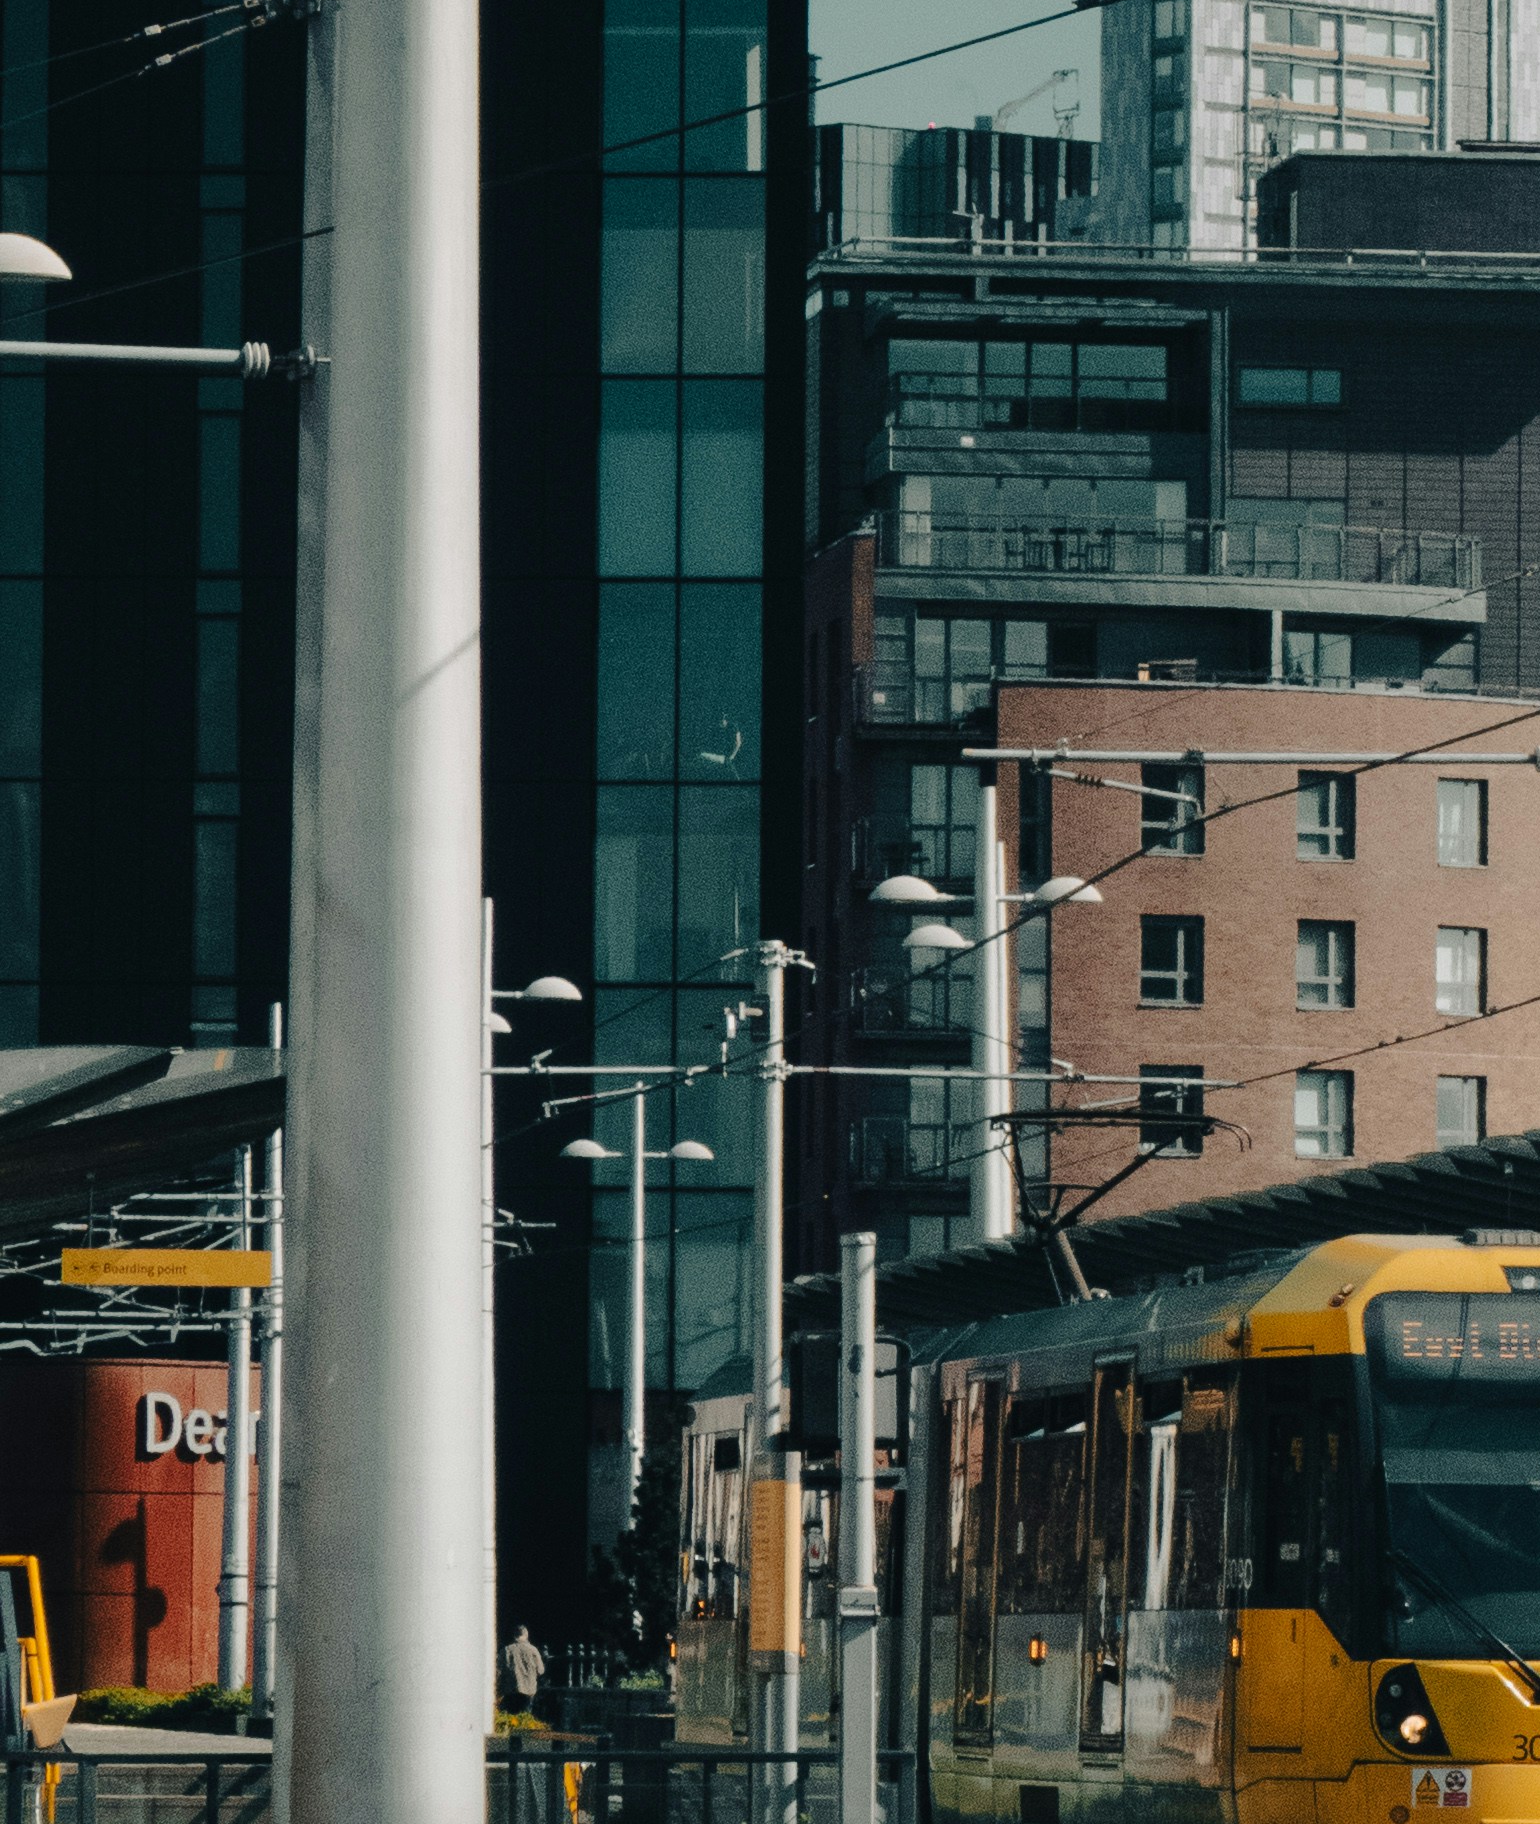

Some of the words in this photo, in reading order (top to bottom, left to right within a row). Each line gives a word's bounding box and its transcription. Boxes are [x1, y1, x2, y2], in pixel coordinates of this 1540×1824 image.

[103, 1262, 154, 1277] Boarding
[157, 1263, 187, 1277] point
[1403, 1321, 1483, 1359] East
